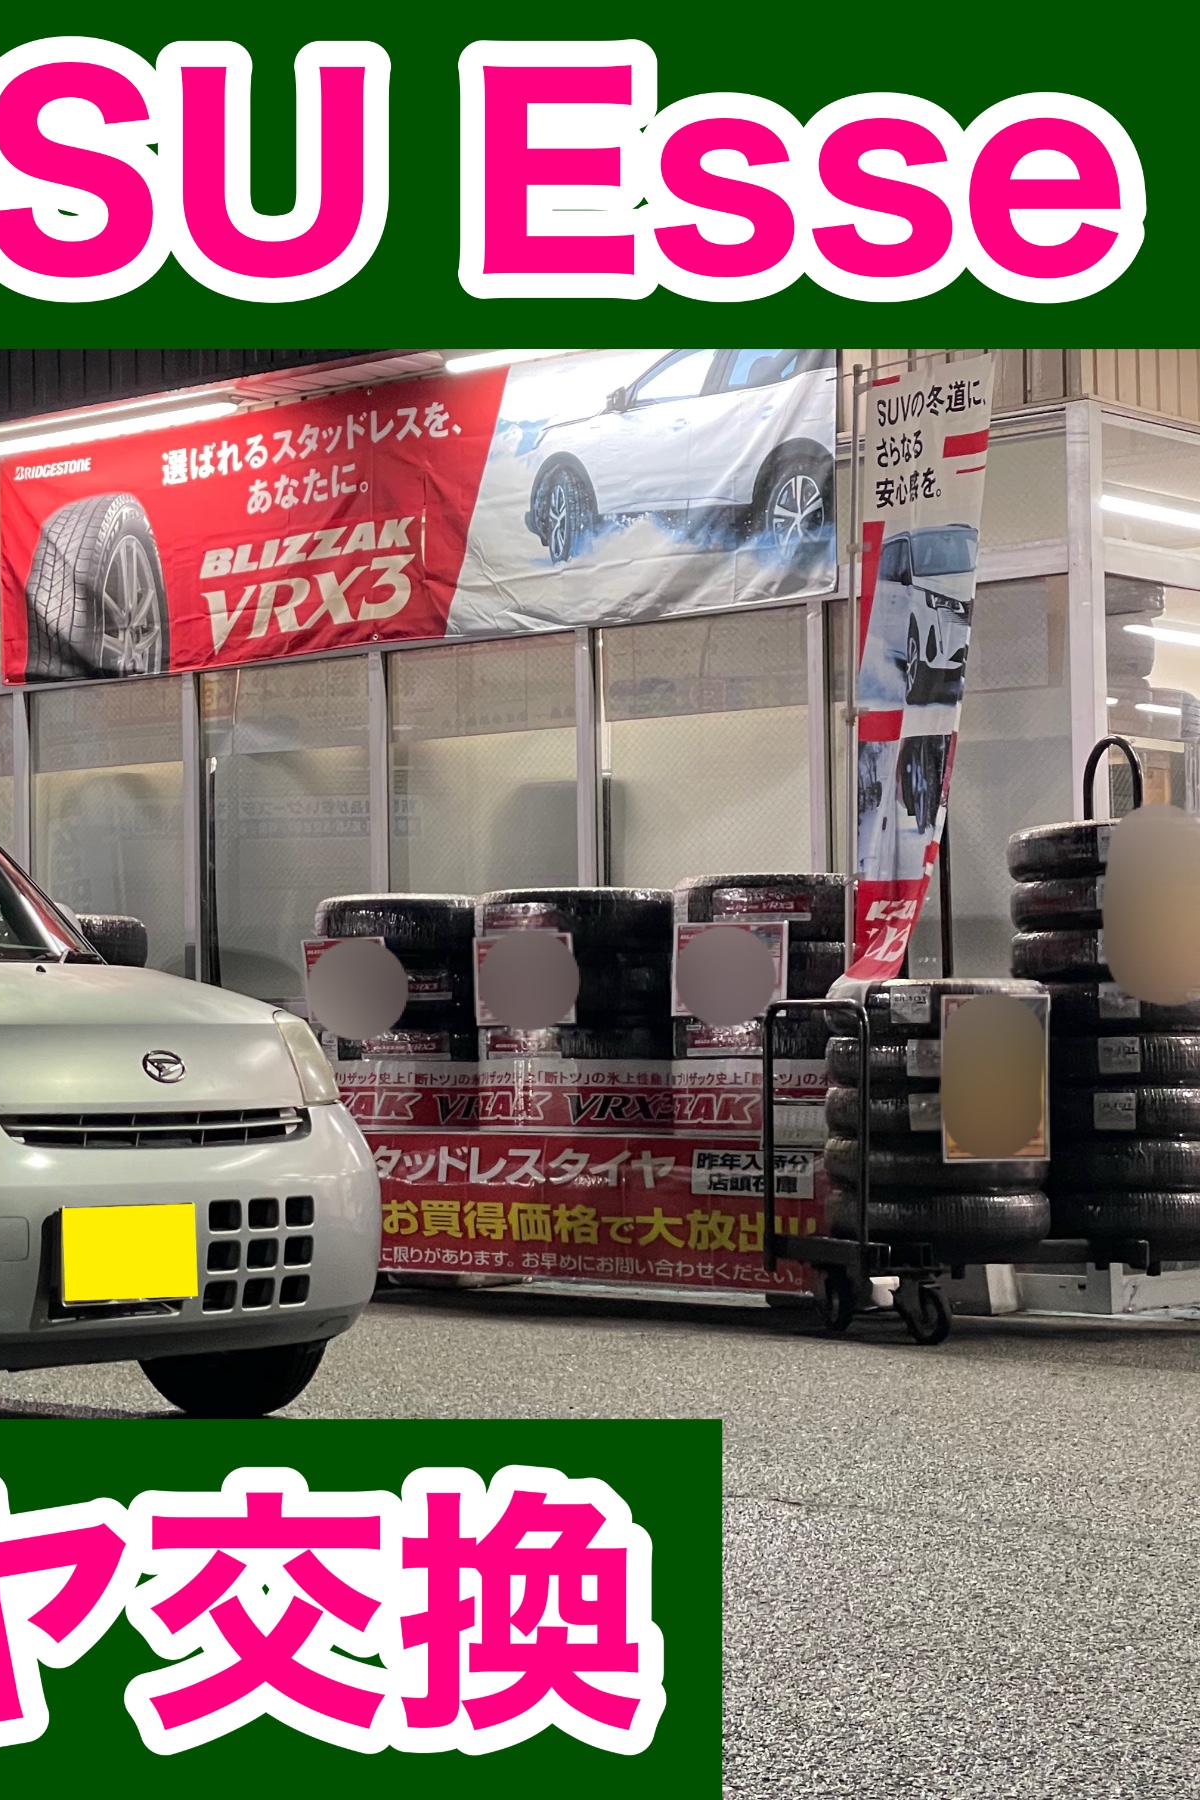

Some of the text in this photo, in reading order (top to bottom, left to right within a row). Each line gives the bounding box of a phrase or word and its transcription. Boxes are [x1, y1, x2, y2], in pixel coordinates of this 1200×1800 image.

[876, 379, 986, 428] SUVの冬道に、
[13, 456, 92, 482] BRIDGESTONE
[161, 402, 462, 486] 選ばれるスタッドレスを、
[875, 430, 923, 468] さらなる
[246, 463, 369, 516] あなたに。
[875, 467, 942, 509] 安心感を。
[200, 516, 415, 579] BLIZZAK
[200, 553, 416, 657] VRX3
